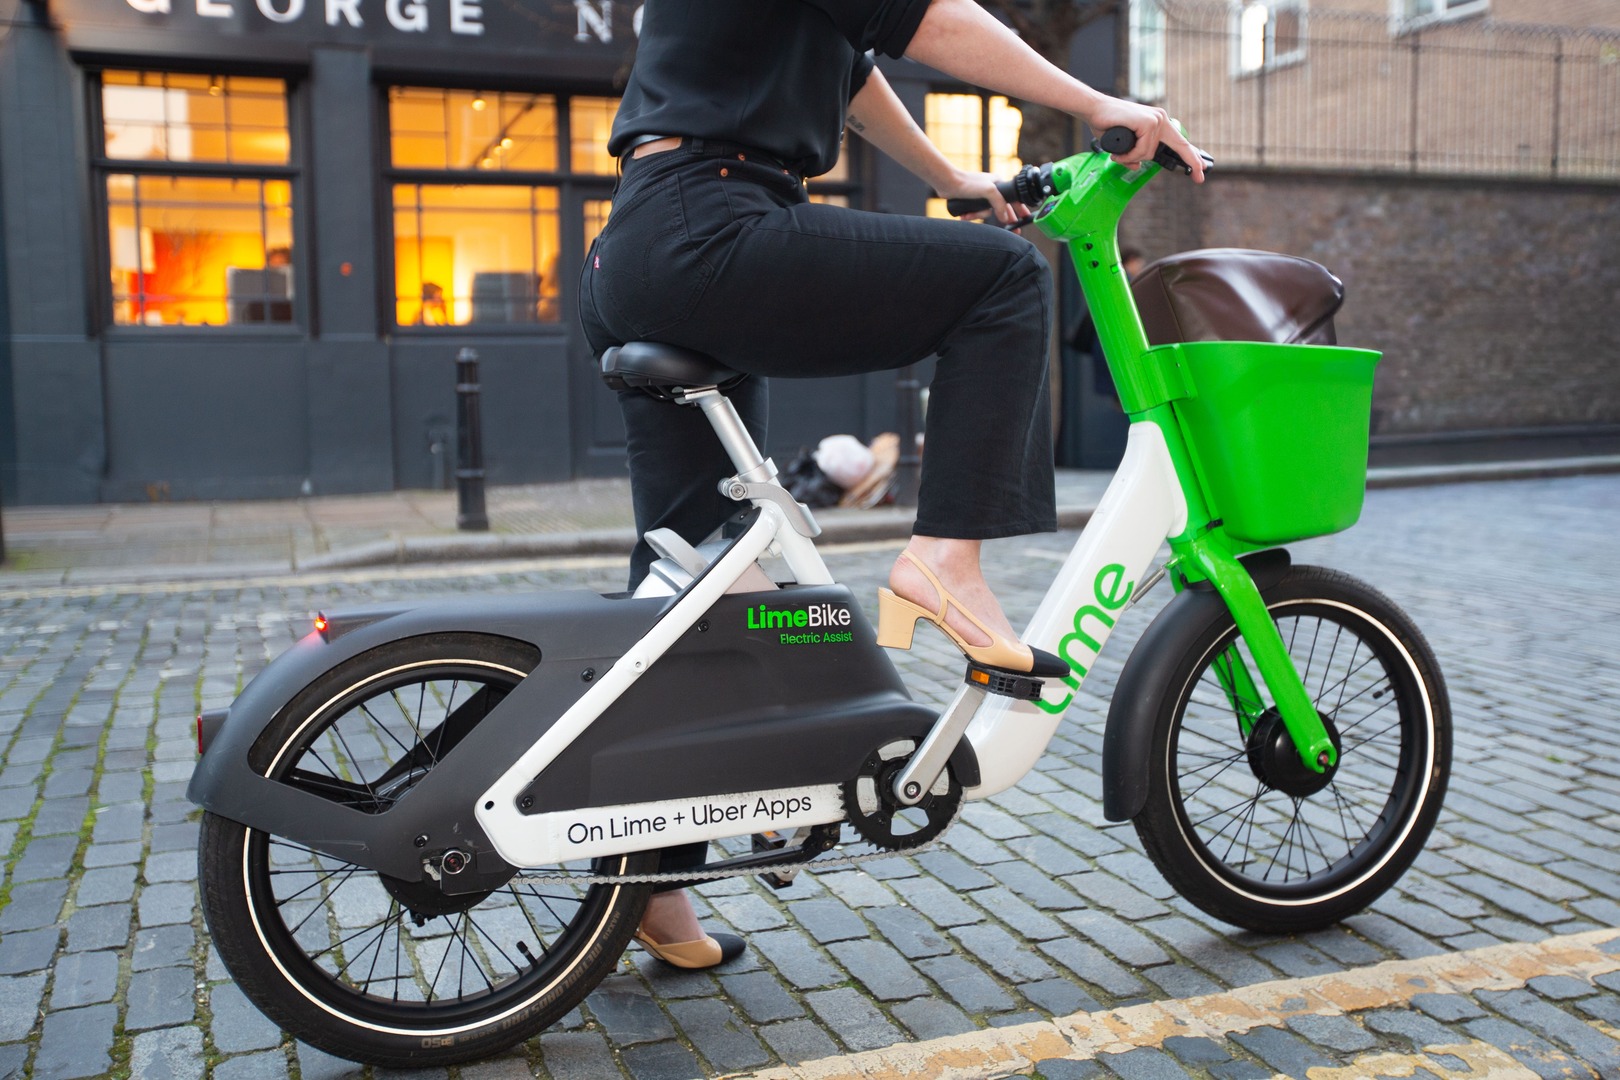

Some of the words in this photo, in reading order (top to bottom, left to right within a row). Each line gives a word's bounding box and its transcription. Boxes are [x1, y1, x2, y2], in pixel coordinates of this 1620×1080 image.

[126, 0, 485, 36] ORGE
[747, 603, 851, 629] LimeBike
[780, 632, 820, 645] Electric
[823, 630, 853, 643] Assist
[568, 822, 603, 844] On
[610, 816, 666, 839] Lime
[692, 803, 747, 826] Uber
[753, 796, 812, 821] Apps
[602, 911, 621, 939] MAXXIS
